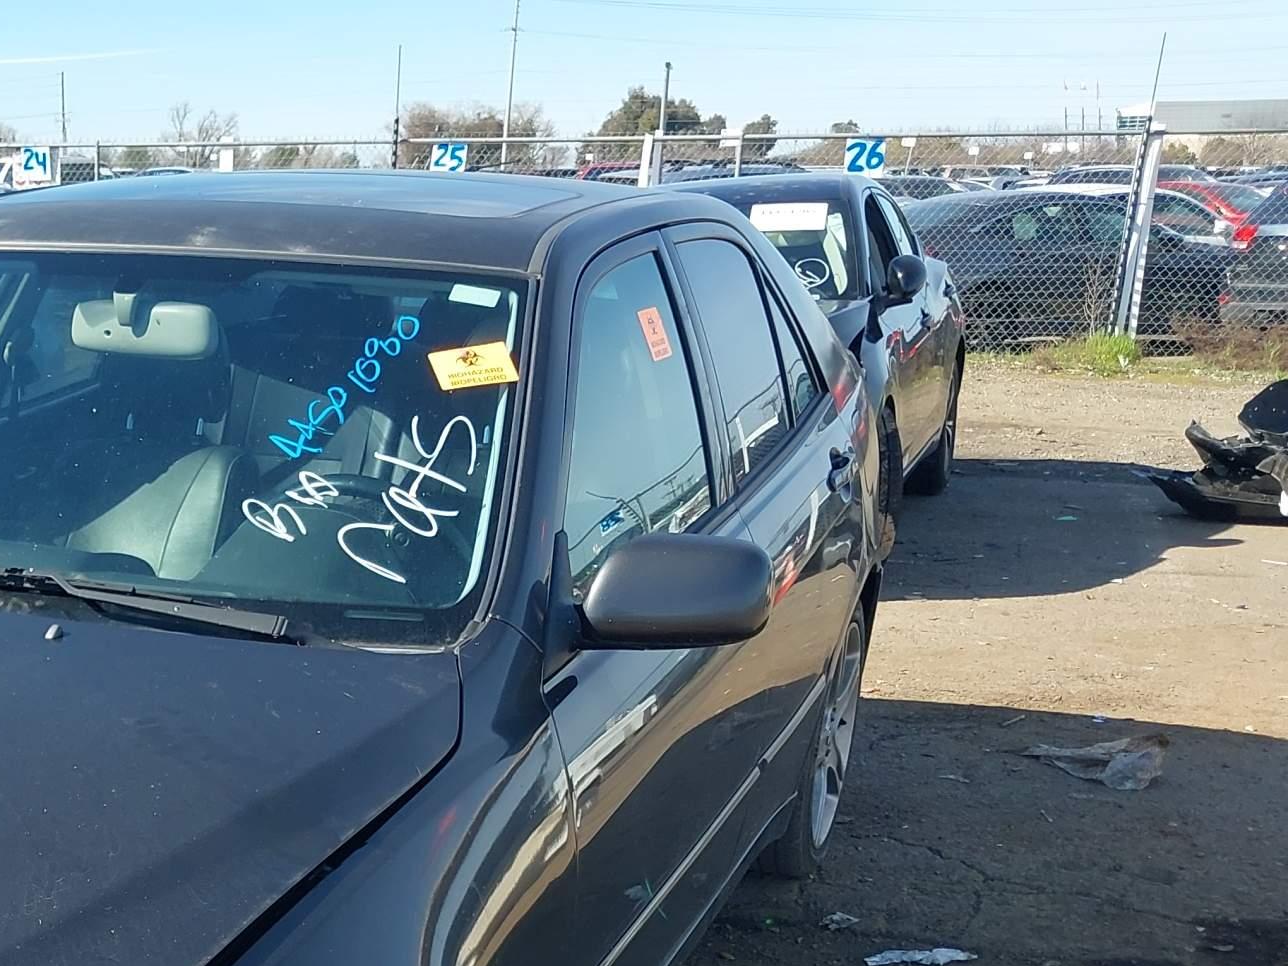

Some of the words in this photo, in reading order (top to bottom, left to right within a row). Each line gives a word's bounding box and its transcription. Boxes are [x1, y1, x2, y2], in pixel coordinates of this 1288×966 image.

[23, 148, 47, 175] 24
[434, 144, 465, 171] 25
[846, 137, 884, 172] 26
